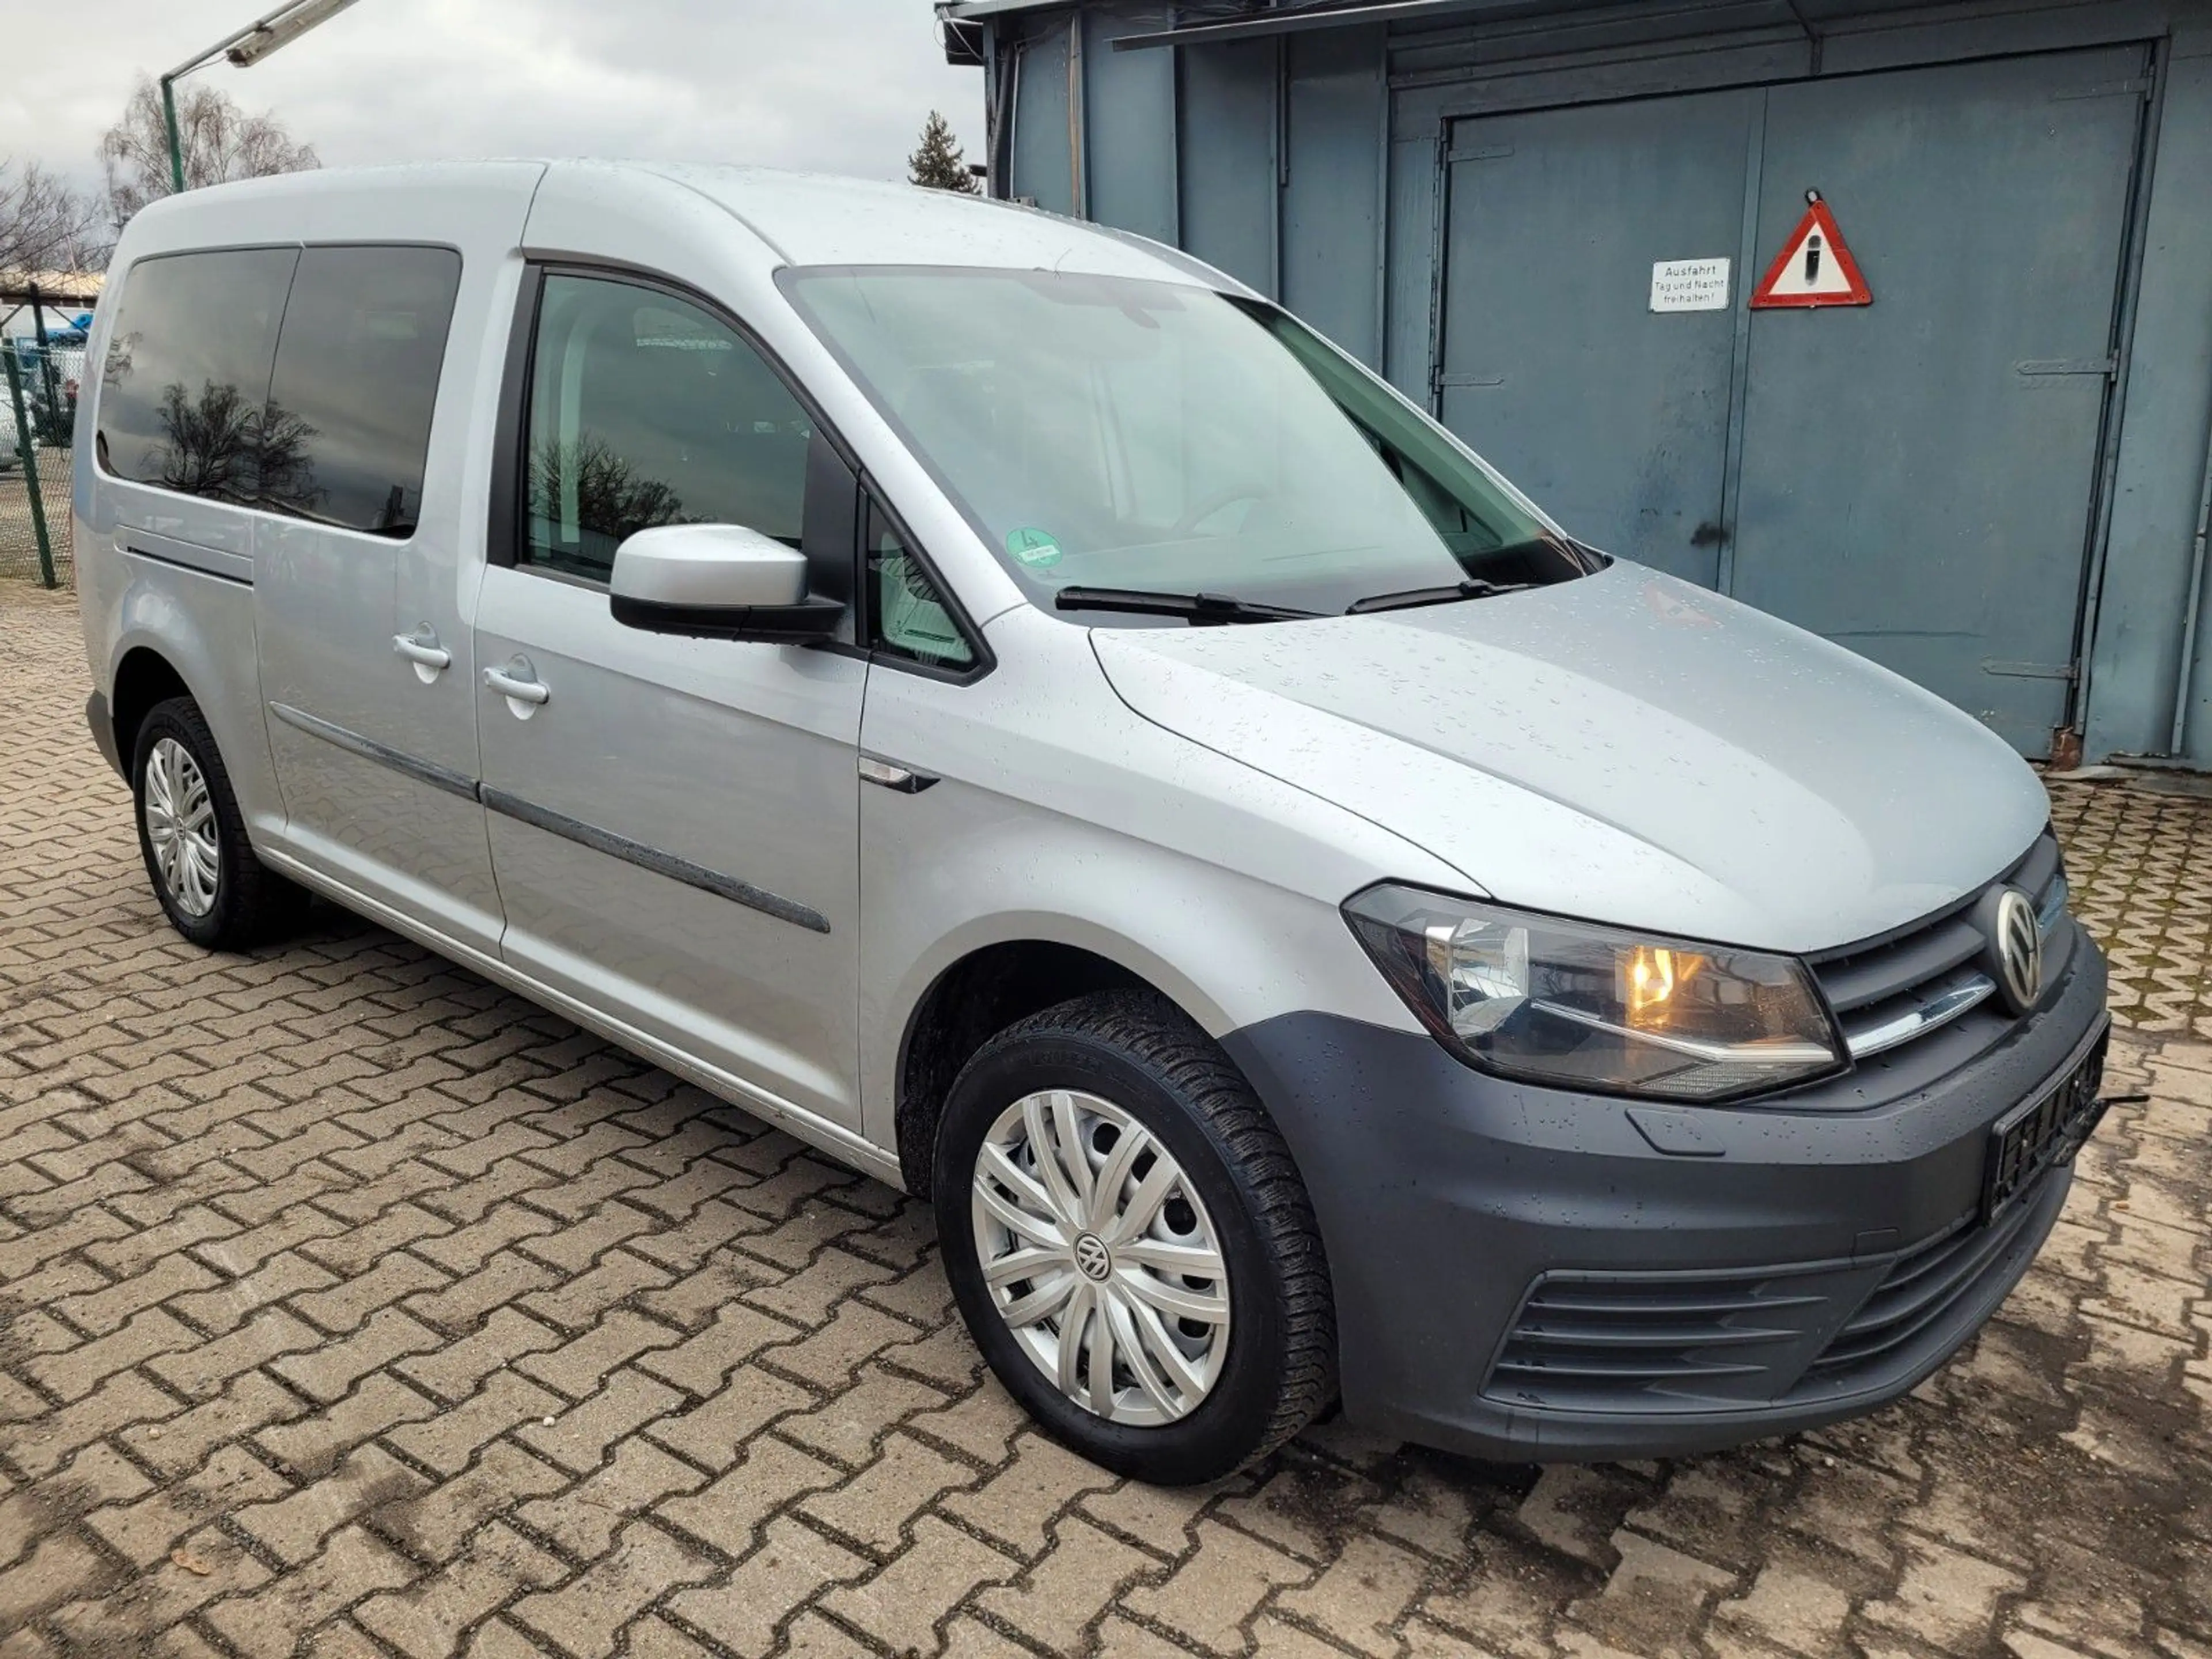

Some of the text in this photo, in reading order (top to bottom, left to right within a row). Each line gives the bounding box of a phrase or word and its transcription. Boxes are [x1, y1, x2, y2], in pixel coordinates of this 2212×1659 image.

[1665, 266, 1717, 276] Ausfahrt
[1655, 279, 1724, 292] Tag und Nacht
[1664, 293, 1715, 304] freihalten!
[1020, 530, 1040, 548] 4
